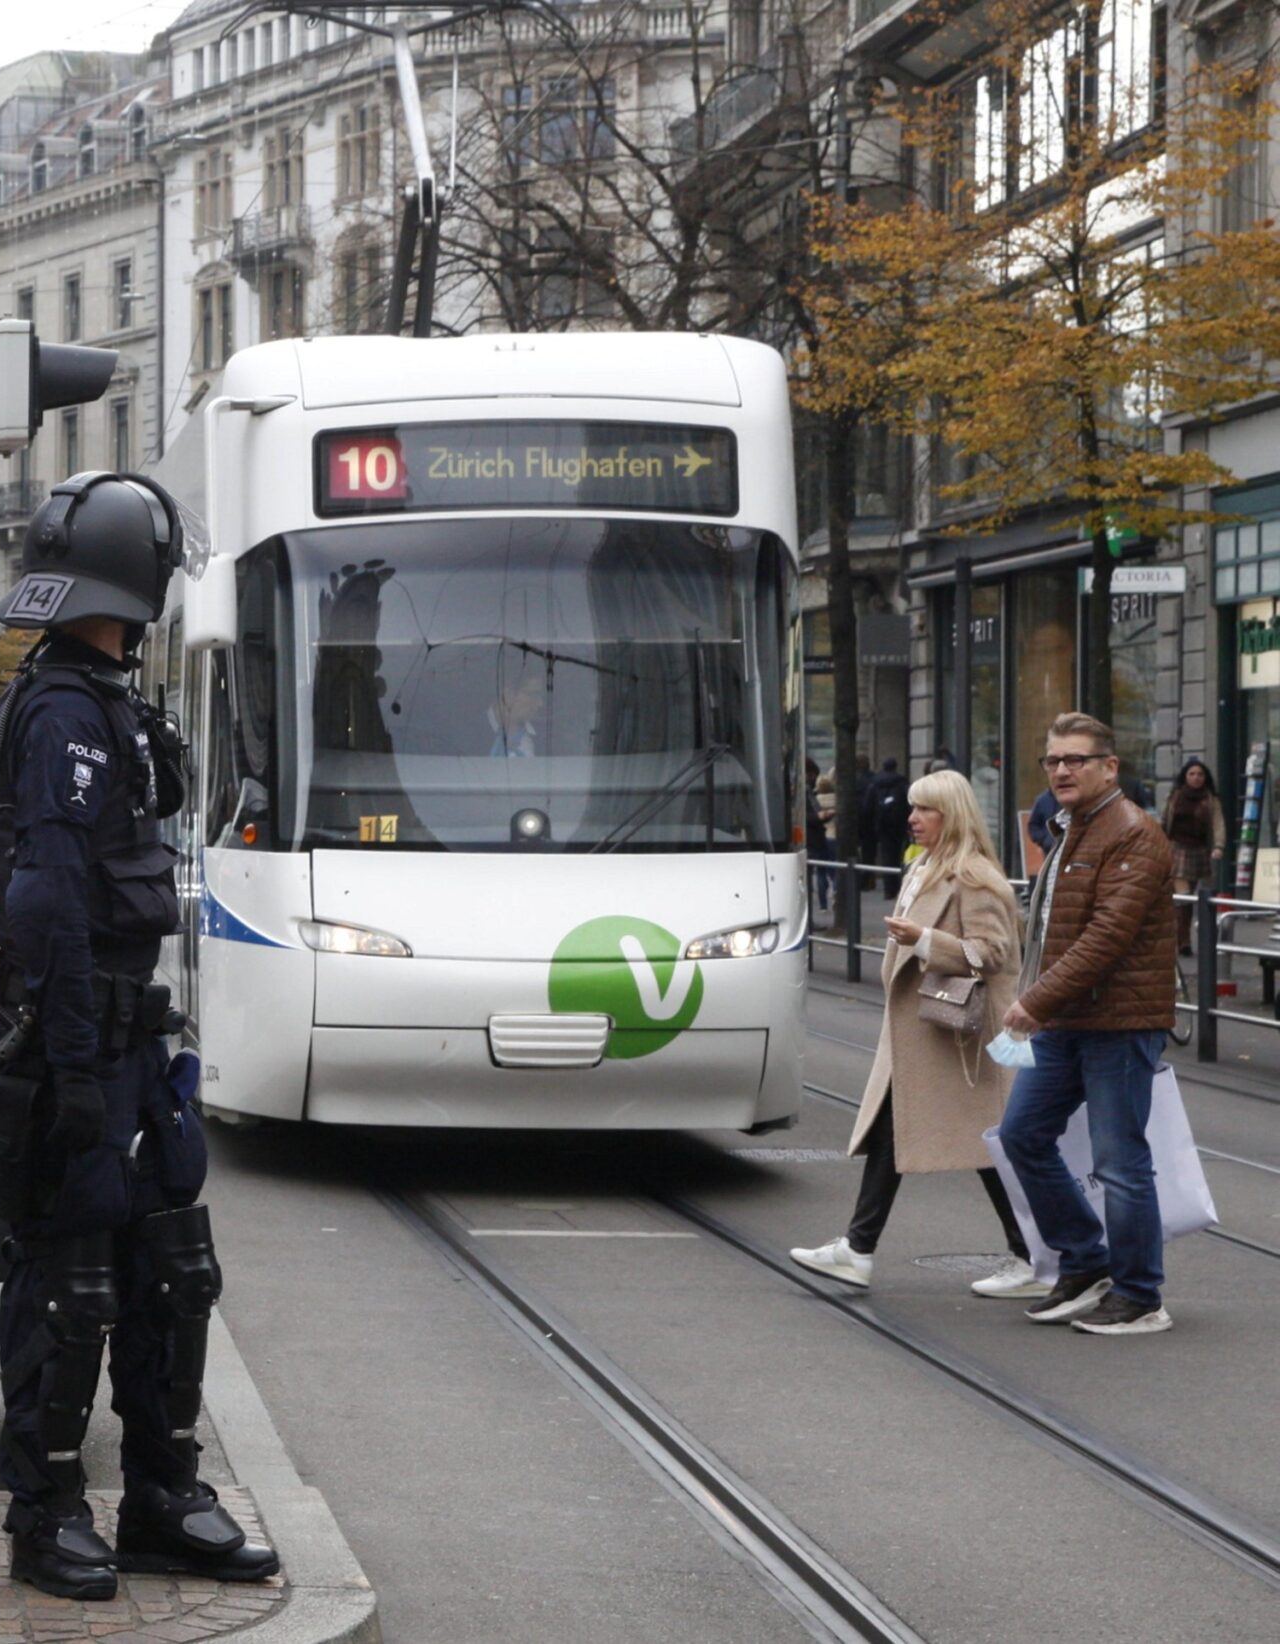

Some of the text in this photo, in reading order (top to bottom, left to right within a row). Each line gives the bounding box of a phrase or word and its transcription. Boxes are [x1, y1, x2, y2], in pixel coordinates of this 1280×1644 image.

[338, 447, 662, 491] 10 Zürich Flughafen
[1115, 571, 1172, 583] CTORIA
[26, 584, 56, 609] 14
[1112, 593, 1154, 624] SPRIT
[67, 742, 108, 765] POLIZEI
